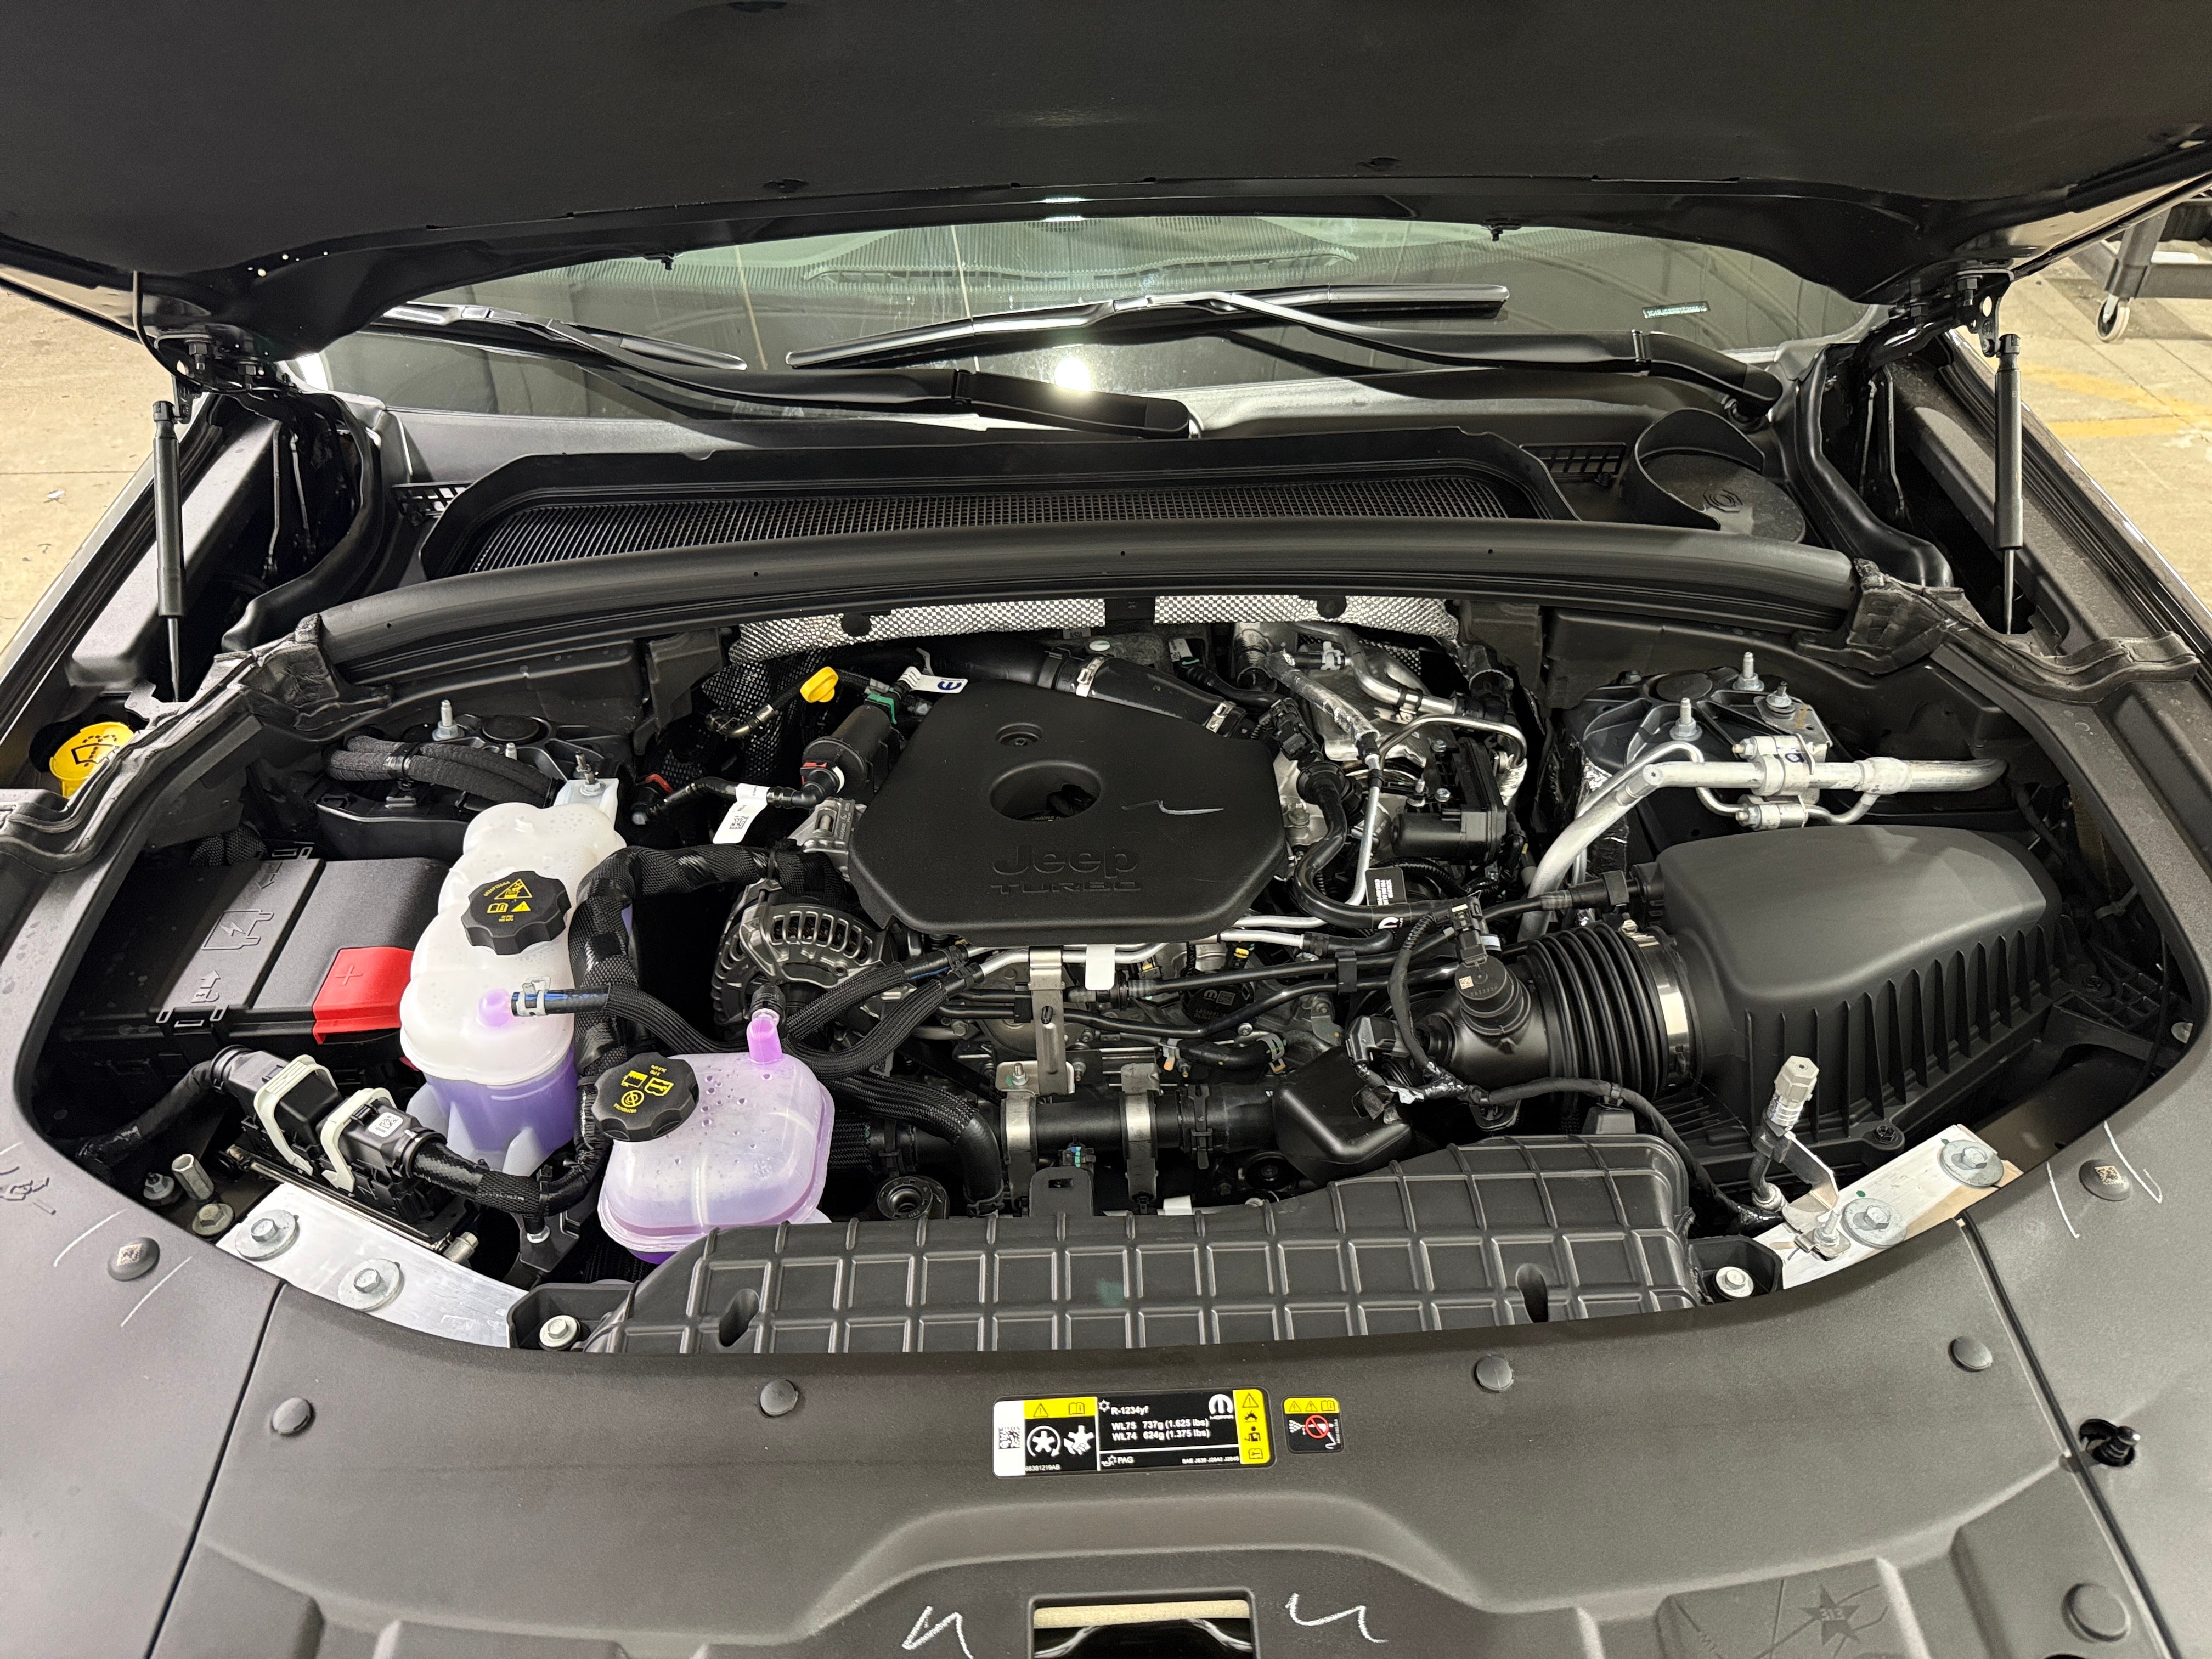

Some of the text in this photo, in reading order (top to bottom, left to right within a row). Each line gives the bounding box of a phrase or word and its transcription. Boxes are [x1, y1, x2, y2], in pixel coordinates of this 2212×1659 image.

[992, 845, 1138, 879] Jeep
[990, 881, 1141, 894] TURBO
[1111, 1405, 1149, 1415] R-1234yf
[1111, 1418, 1209, 1430] WL75 737g (1.625 lbs)
[1112, 1428, 1210, 1441] WL74 624g (1.375 lbs)
[1819, 1607, 1843, 1621] 313
